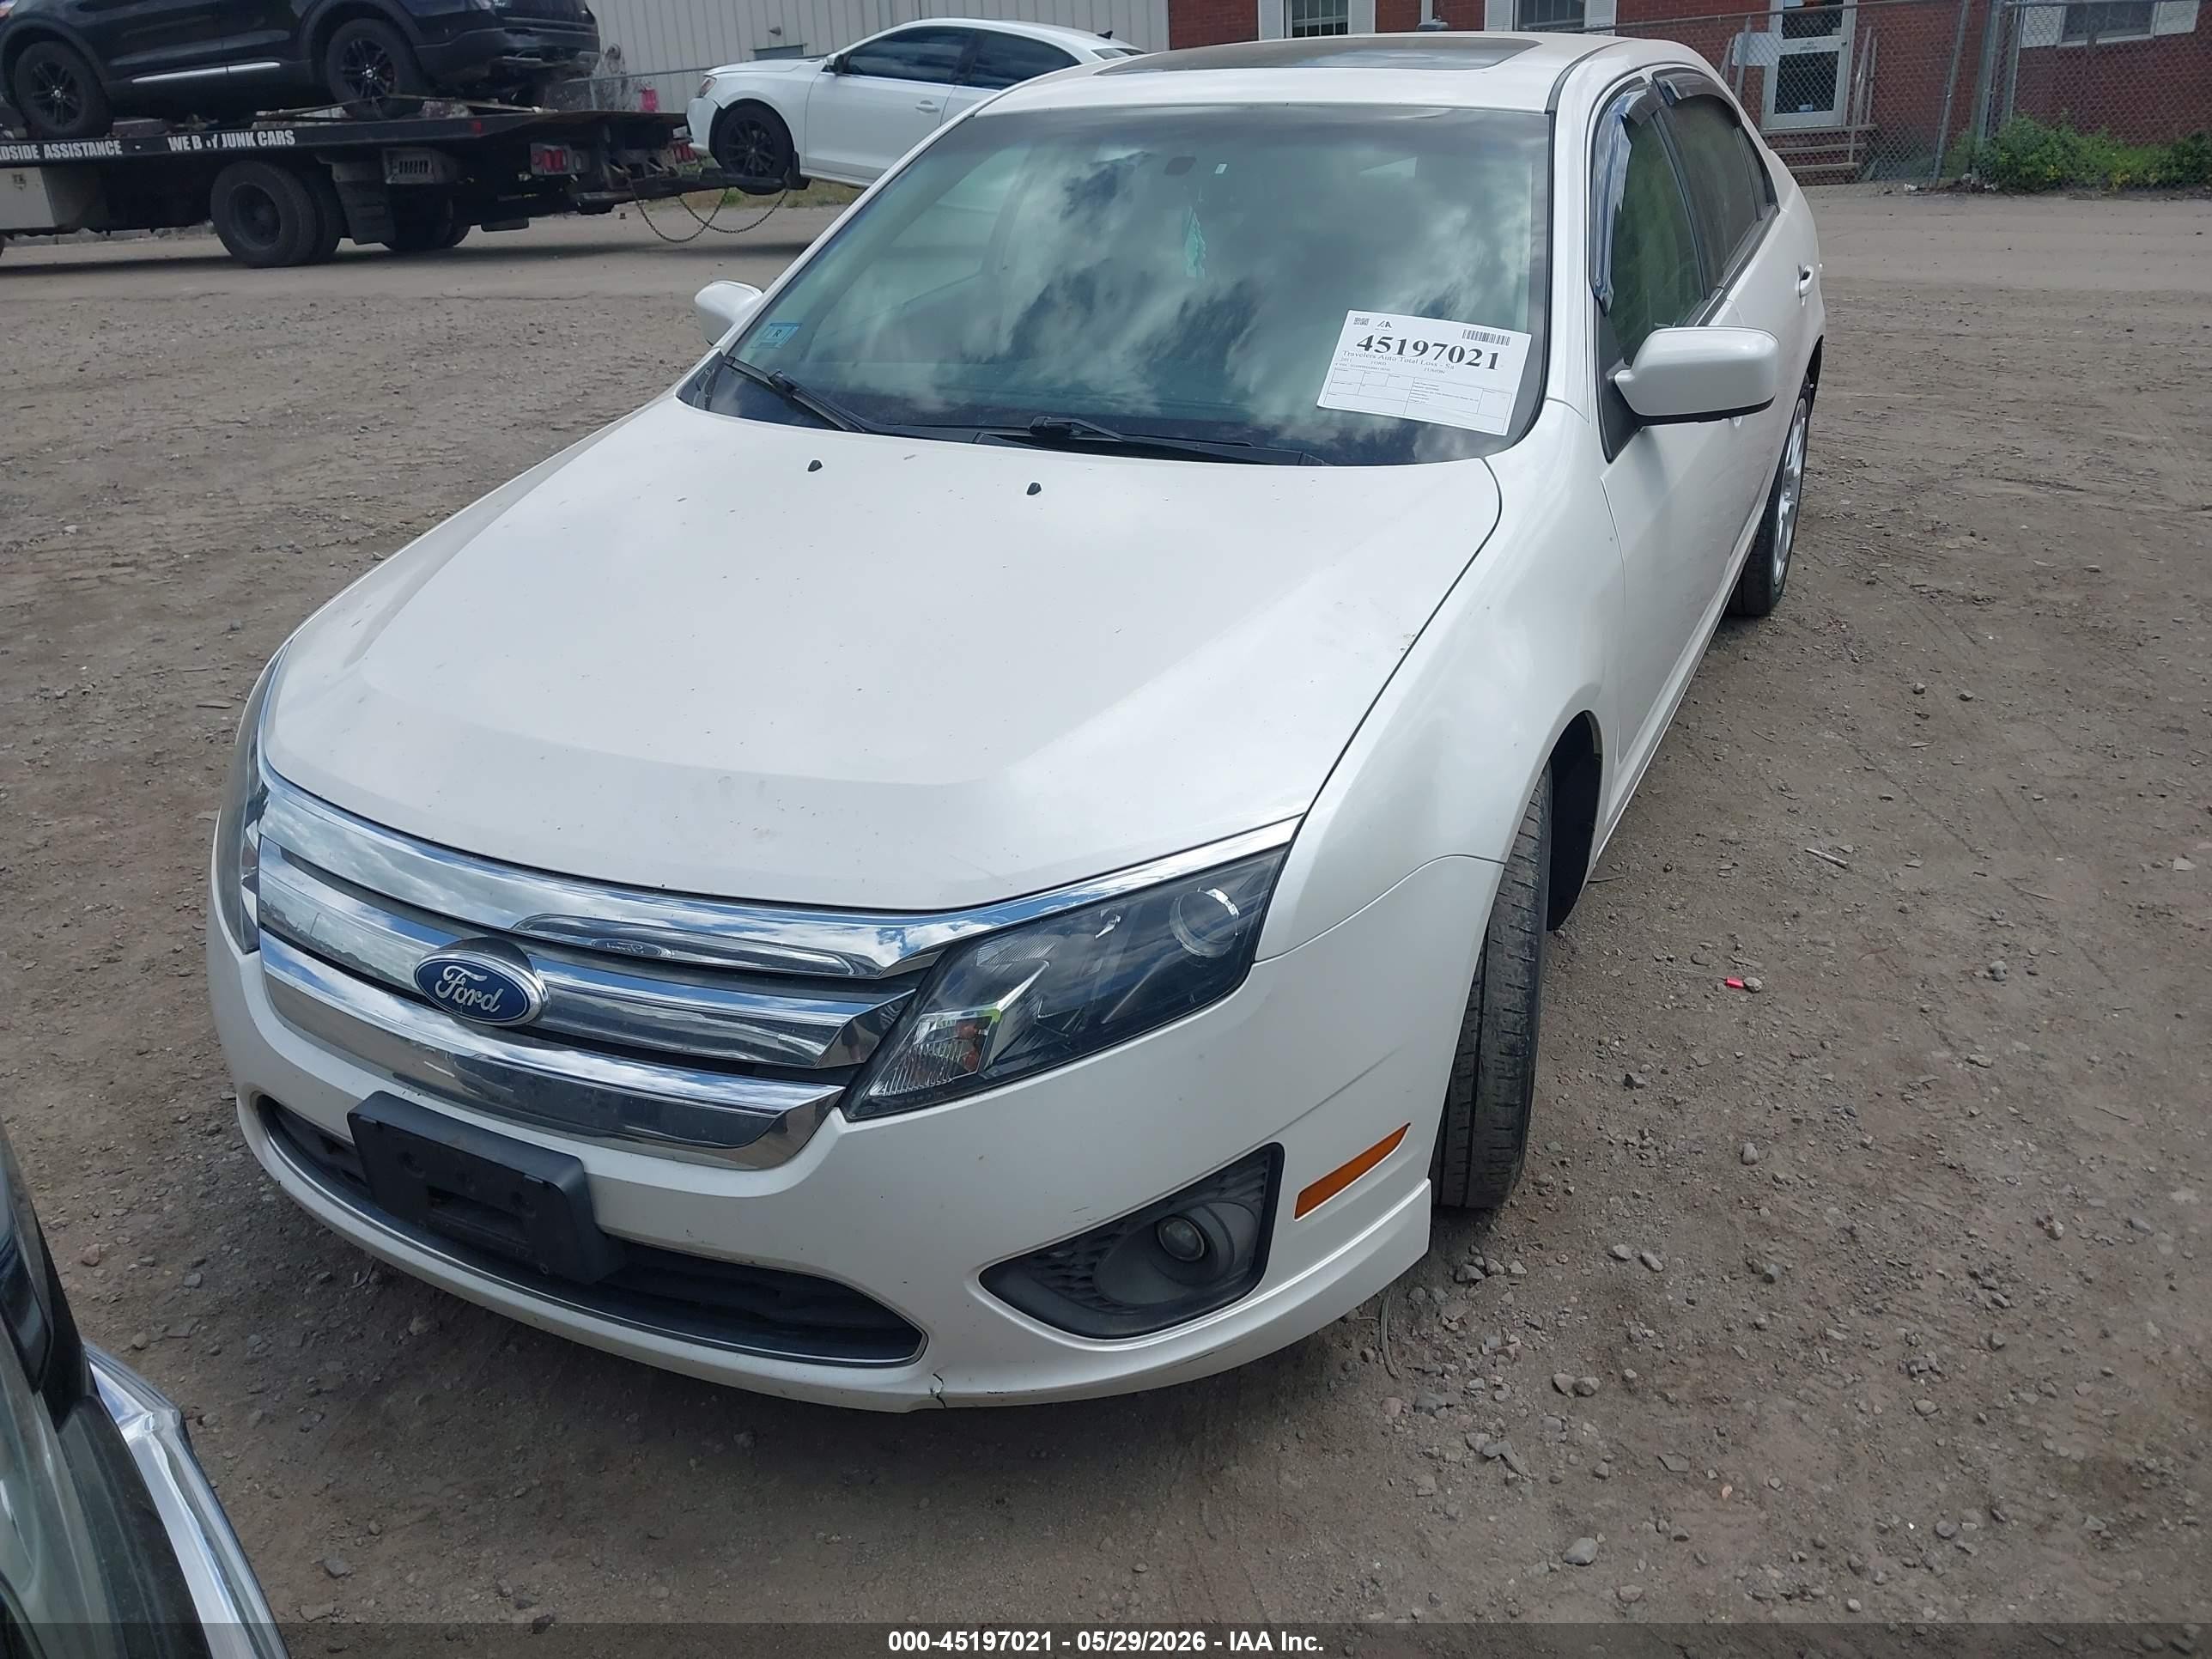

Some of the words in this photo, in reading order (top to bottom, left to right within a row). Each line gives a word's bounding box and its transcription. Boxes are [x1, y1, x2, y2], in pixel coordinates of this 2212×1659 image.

[0, 144, 40, 161] DSIDE
[43, 140, 123, 159] ASSISTANCE
[167, 137, 191, 151] WE
[191, 134, 218, 149] BY
[222, 131, 256, 148] JUNK
[257, 130, 295, 146] CARS
[1342, 350, 1376, 359] Travelers
[1400, 356, 1419, 365] Total
[1357, 334, 1498, 370] 45197021
[434, 965, 503, 1012] Ford
